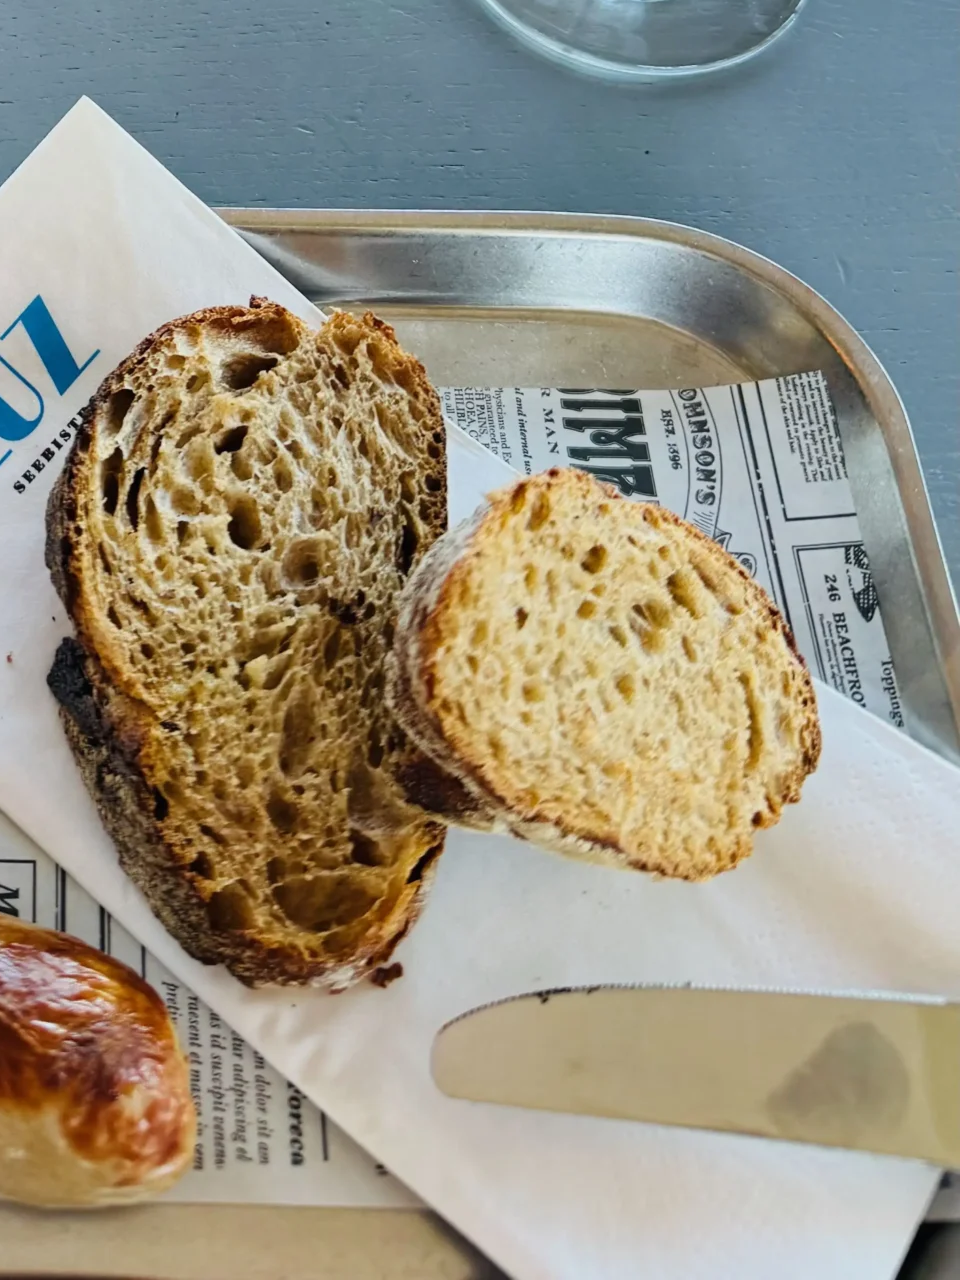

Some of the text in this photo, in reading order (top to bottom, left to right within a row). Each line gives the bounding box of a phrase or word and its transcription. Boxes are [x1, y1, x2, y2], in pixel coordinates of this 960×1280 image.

[483, 393, 499, 444] guaranteed
[515, 397, 533, 459] and internal
[542, 408, 560, 454] MAN
[500, 431, 511, 450] and
[824, 574, 841, 602] 246
[189, 1051, 203, 1065] et
[207, 1034, 229, 1112] id suscipit
[225, 1063, 249, 1143] adipiscing
[254, 1074, 272, 1114] dolor
[257, 1118, 274, 1138] sit
